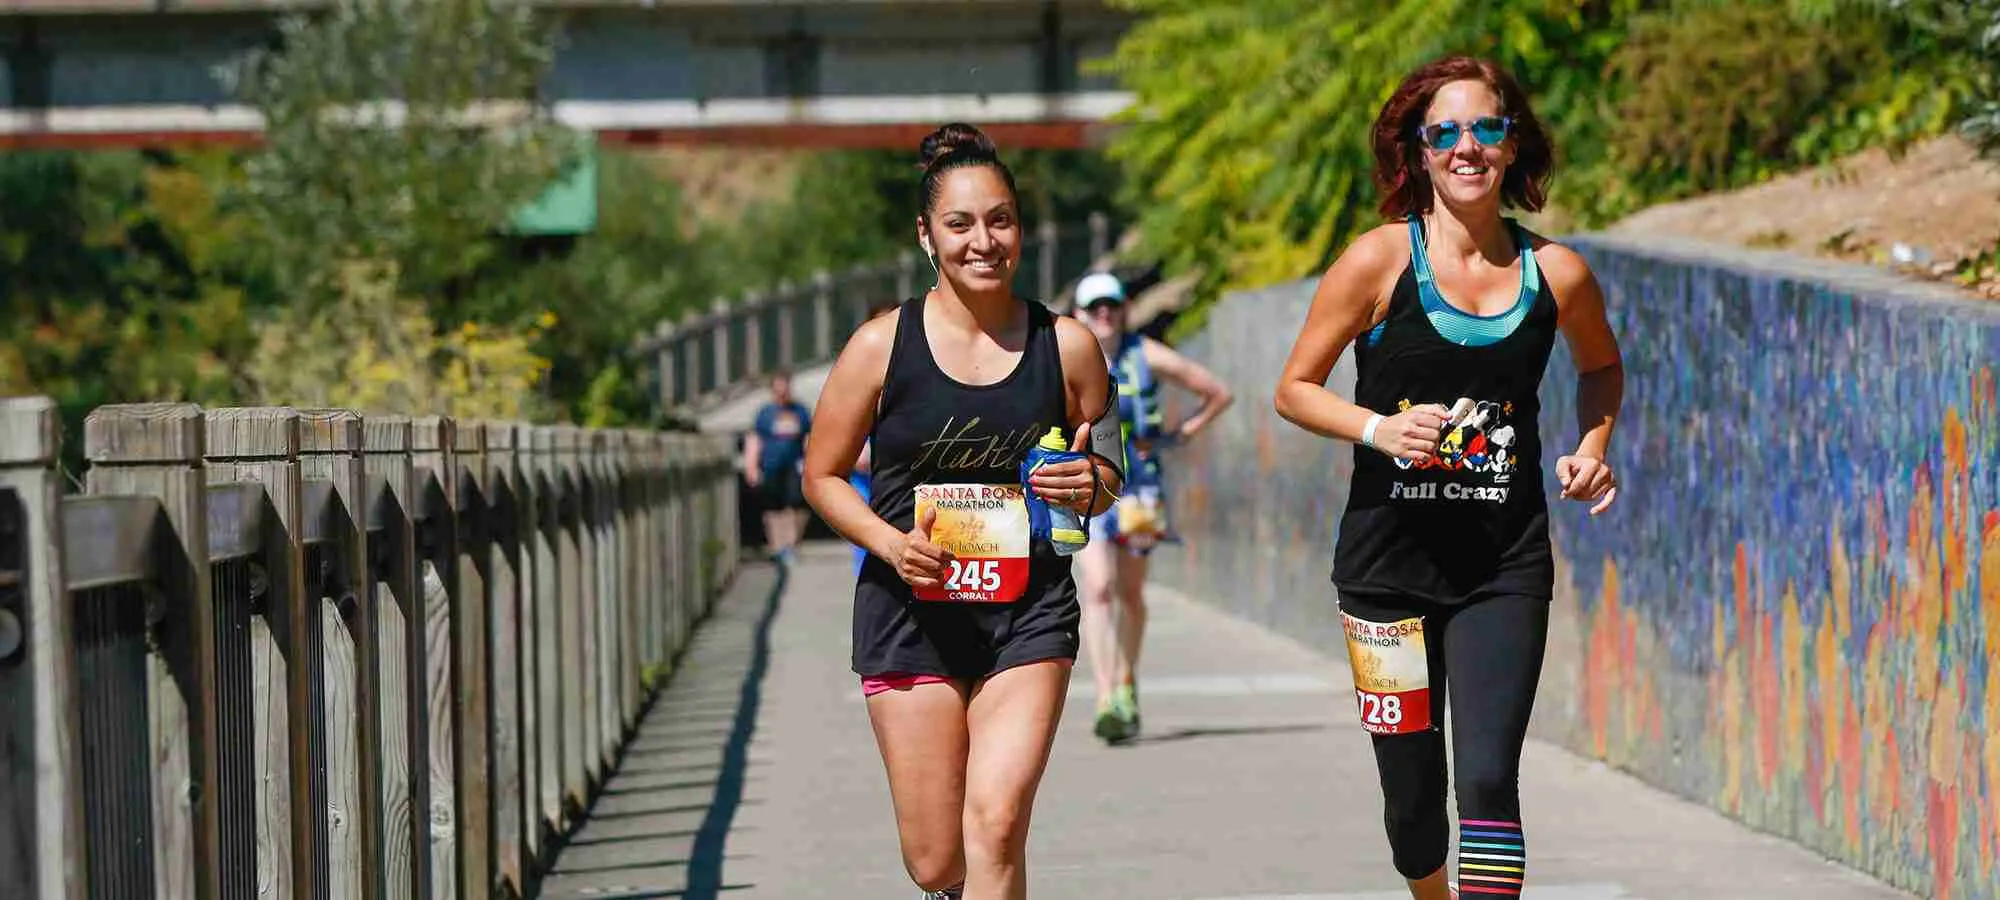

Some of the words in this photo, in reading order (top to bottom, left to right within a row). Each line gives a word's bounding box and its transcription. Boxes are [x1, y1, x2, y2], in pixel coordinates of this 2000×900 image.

[920, 487, 976, 499] SANTA
[1389, 481, 1437, 499] Full
[1443, 482, 1510, 503] Crazy
[936, 500, 1004, 509] MARATHON
[944, 560, 1000, 591] 245
[949, 592, 987, 600] CORRAL
[990, 592, 994, 600] 1
[1357, 688, 1402, 725] 728
